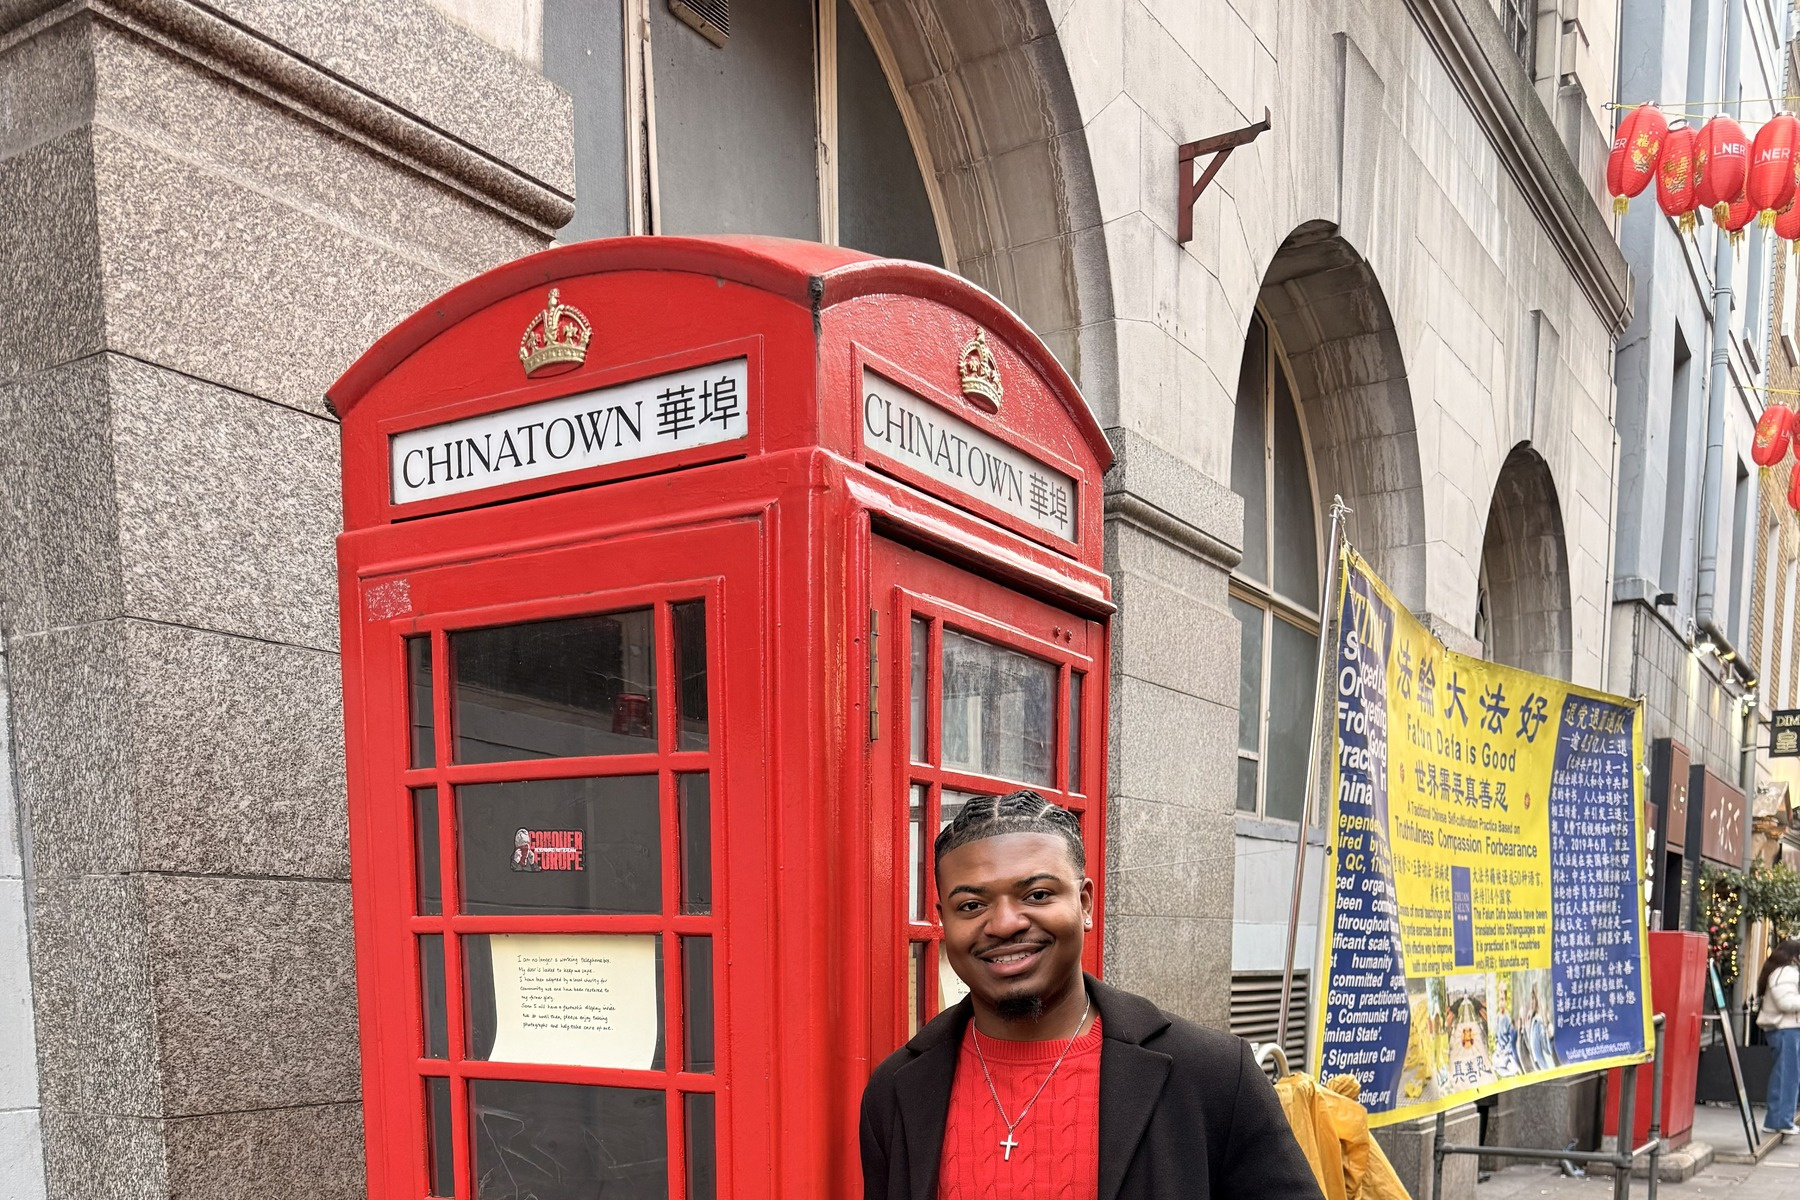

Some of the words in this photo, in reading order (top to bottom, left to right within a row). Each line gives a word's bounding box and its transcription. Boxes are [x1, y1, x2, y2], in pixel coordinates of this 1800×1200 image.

[1714, 142, 1746, 156] LNER
[1754, 148, 1791, 165] LNER
[402, 401, 644, 489] CHINATOWN
[656, 375, 740, 440] 華埠
[864, 392, 1025, 505] CHINATOWN
[1028, 471, 1070, 531] 華埠
[1396, 638, 1548, 743] 法輪大法好
[1407, 712, 1432, 751] Falun
[1436, 728, 1462, 762] Dafa
[1465, 737, 1476, 766] is
[1481, 741, 1516, 773] Good
[1339, 772, 1373, 805] hina
[1414, 758, 1509, 812] 世界需要真善忍
[529, 831, 583, 850] CONQUER
[1338, 831, 1363, 850] ired
[1438, 828, 1482, 855] Compassion
[1485, 836, 1537, 858] Forbearance
[534, 851, 583, 871] EUROPE
[1345, 853, 1366, 874] QC,
[1336, 874, 1355, 890] ced
[1336, 893, 1362, 911] been
[1338, 914, 1389, 935] throughout
[1333, 932, 1367, 951] ificant
[1352, 953, 1393, 971] humanity
[1333, 973, 1384, 988] committed
[1328, 990, 1355, 1009] Gong
[1338, 1007, 1388, 1025] Communist
[1391, 1007, 1408, 1025] Party
[1324, 1027, 1355, 1042] iminal
[1328, 1048, 1377, 1069] Signature
[1379, 1047, 1396, 1063] Can
[1357, 1088, 1391, 1105] sting.org
